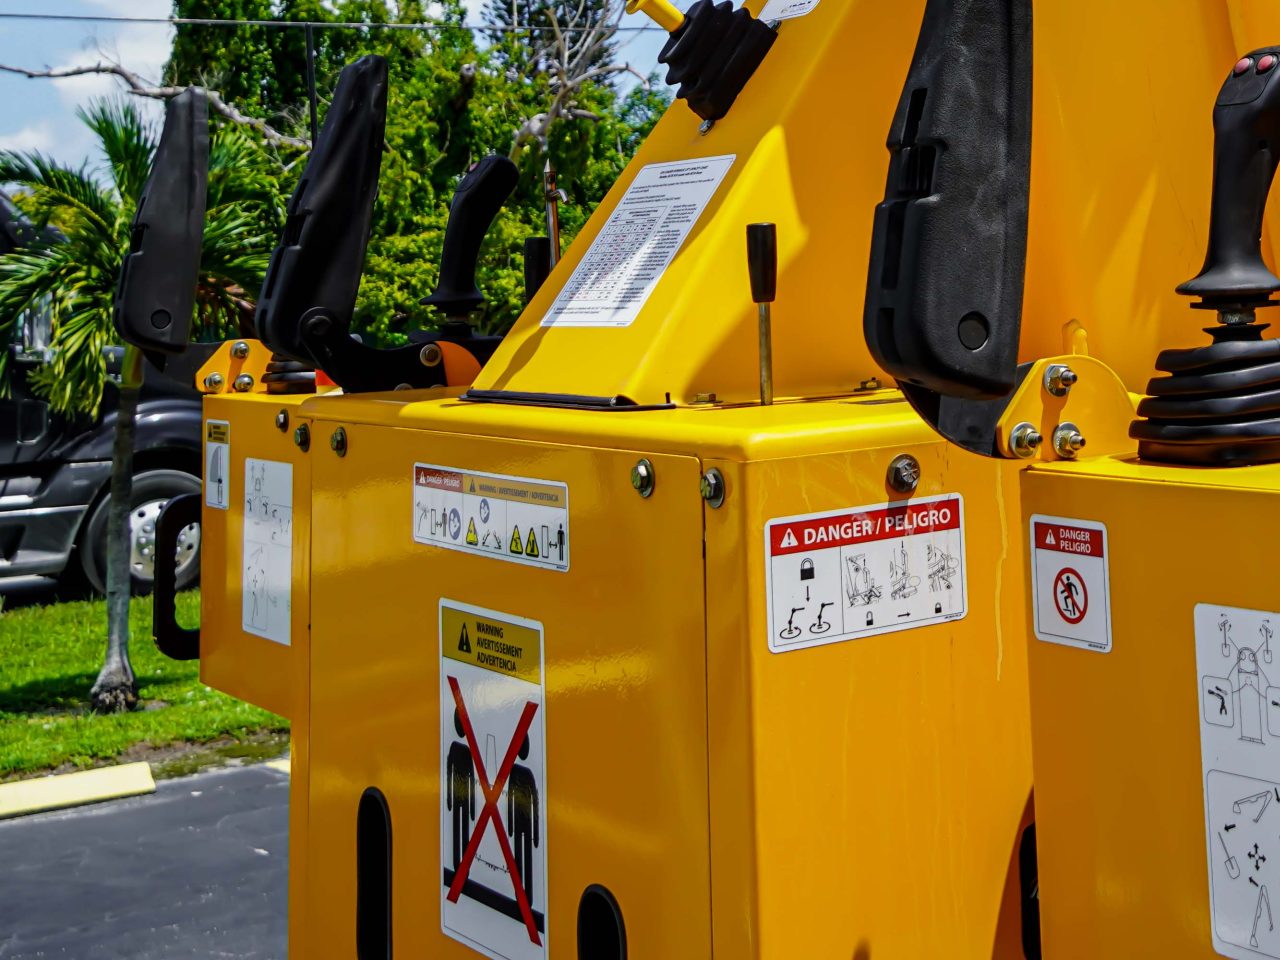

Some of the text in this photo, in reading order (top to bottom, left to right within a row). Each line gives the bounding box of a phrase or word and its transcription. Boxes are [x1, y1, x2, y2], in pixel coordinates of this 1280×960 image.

[804, 508, 951, 545] DANGER / PELIGRO
[1060, 528, 1091, 542] DANGER
[1060, 539, 1092, 554] PELIGRO
[476, 622, 504, 639] WARNING
[476, 637, 523, 659] AVERTISSEMENT
[476, 652, 517, 672] ADVERTENCIA
